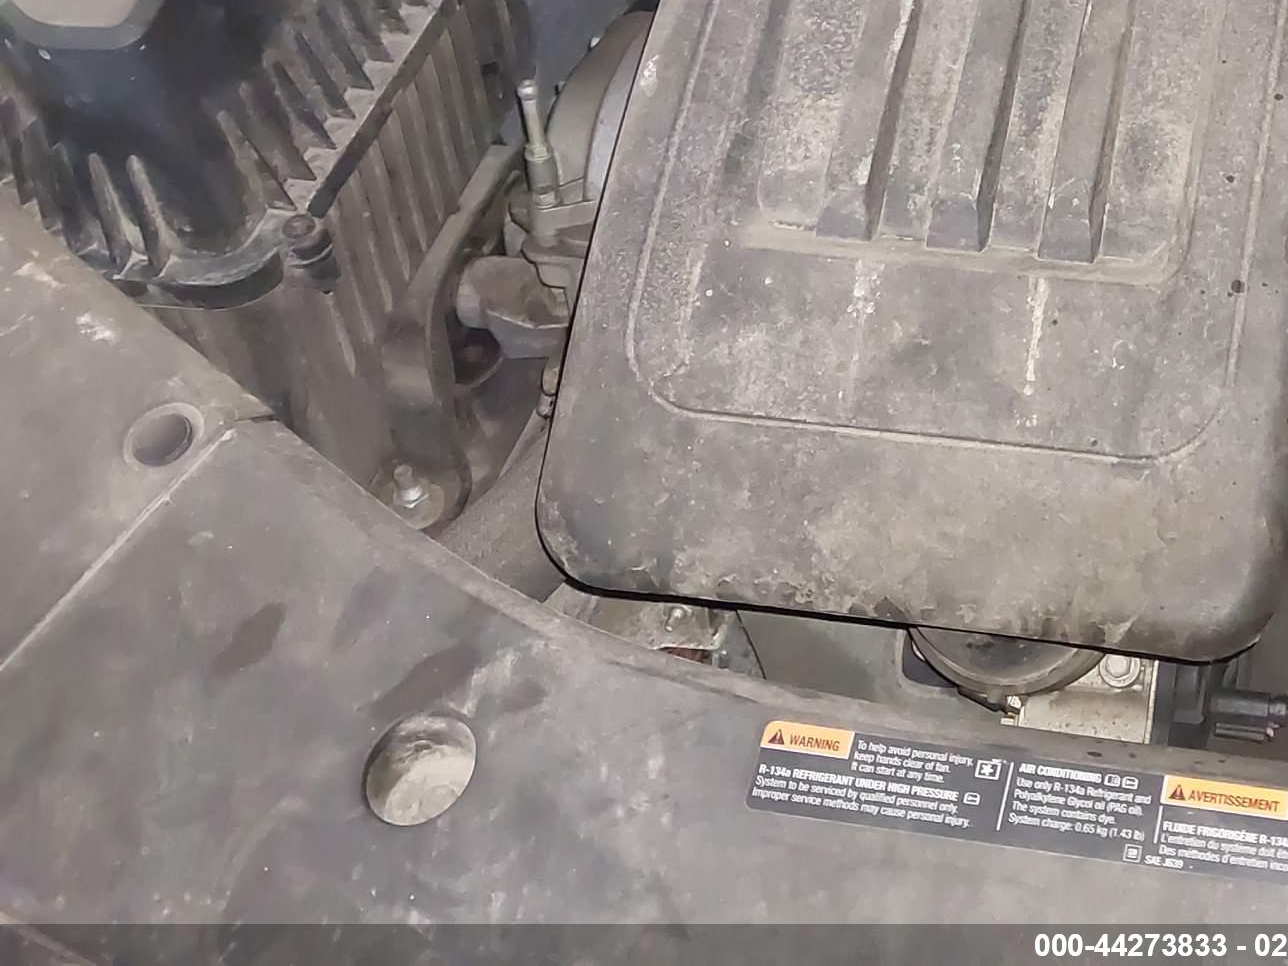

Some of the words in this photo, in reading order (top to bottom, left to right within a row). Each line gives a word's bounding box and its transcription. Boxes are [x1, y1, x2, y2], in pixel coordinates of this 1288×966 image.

[790, 735, 840, 751] WARNING
[857, 739, 868, 751] To
[868, 742, 887, 755] help
[887, 746, 911, 757] avoid
[911, 749, 948, 762] personal
[948, 753, 974, 767] injury,
[853, 751, 875, 763] keep
[875, 754, 901, 766] hands
[902, 758, 924, 769] clear
[924, 761, 935, 771] of
[758, 764, 792, 777] R-134a
[792, 769, 854, 786] REFRIGERANT
[855, 777, 887, 791] UNDER
[887, 782, 911, 794] HIGH
[911, 786, 959, 801] PRESSURE
[850, 761, 858, 771] It
[858, 764, 874, 773] can
[875, 766, 896, 776] start
[895, 769, 905, 778] at
[906, 770, 923, 782] any
[923, 772, 944, 783] time.
[1018, 763, 1037, 774] AIR
[1037, 766, 1102, 783] CONDITIONING
[754, 776, 787, 789] System
[787, 780, 797, 790] to
[797, 781, 810, 792] be
[810, 785, 847, 797] serviced
[846, 788, 859, 802] by
[859, 792, 896, 804] qualified
[896, 797, 938, 810] personnel
[938, 803, 958, 815] only.
[1016, 777, 1033, 788] Use
[1033, 780, 1053, 793] only
[1053, 782, 1086, 796] R-134a
[1086, 787, 1134, 802] Refrigerant
[1134, 795, 1152, 805] and
[1189, 790, 1279, 811] AVERTISSEMENT
[752, 787, 790, 801] Improper
[791, 794, 822, 805] service
[822, 798, 859, 811] methods
[860, 803, 880, 816] may
[880, 807, 906, 818] cause
[906, 810, 944, 823] personal
[944, 814, 970, 828] injury.
[1012, 800, 1028, 812] The
[1029, 805, 1060, 816] system
[1061, 809, 1097, 821] contains
[1097, 813, 1116, 825] dye.
[1094, 800, 1106, 810] oil
[1008, 812, 1041, 826] System
[1074, 822, 1095, 834] 0.65
[1096, 825, 1108, 838] kg
[1162, 822, 1196, 835] FLUIDE
[1144, 855, 1162, 866] SAE
[1158, 844, 1176, 856] Des
